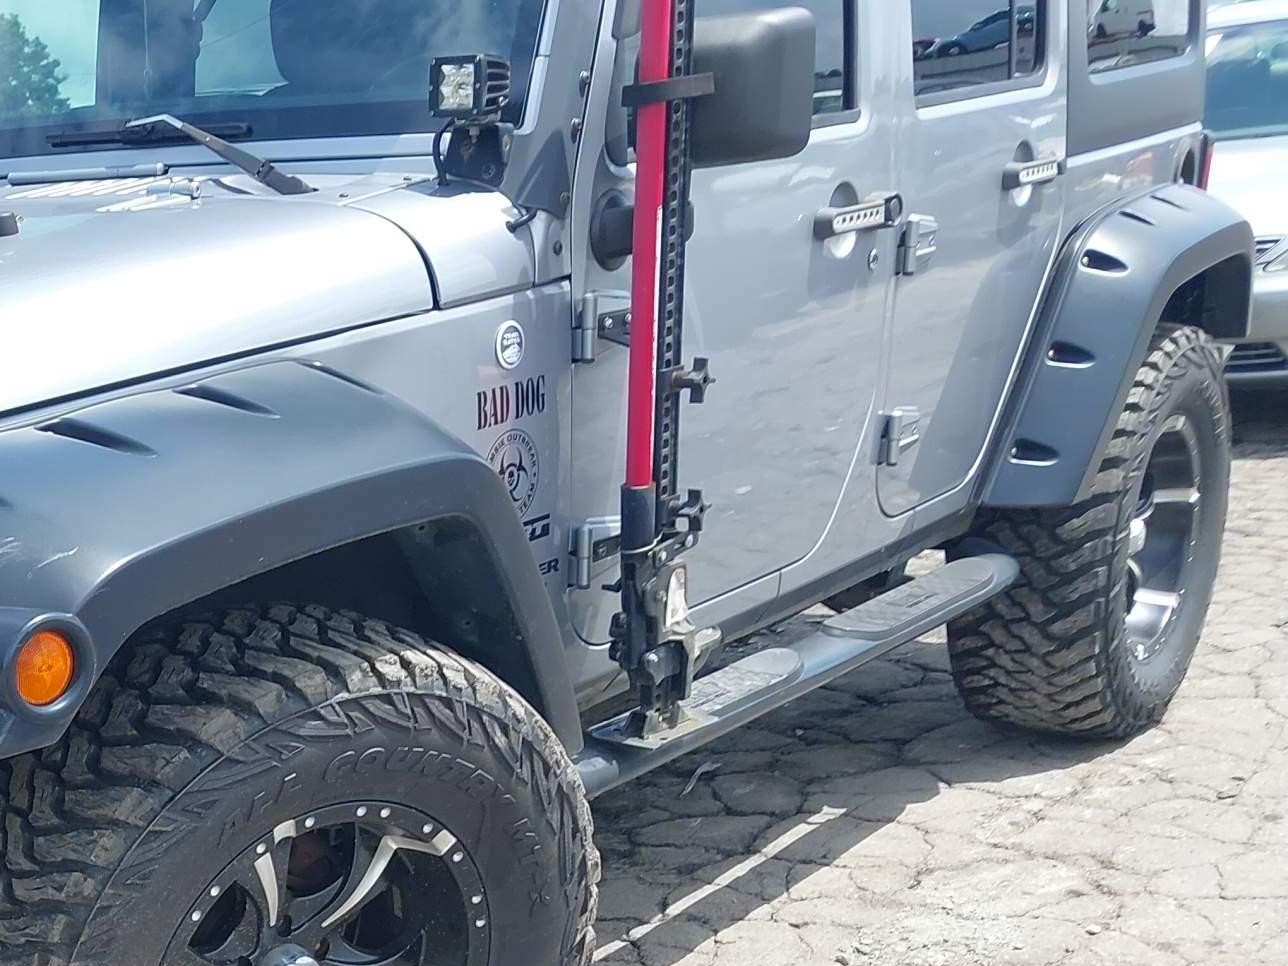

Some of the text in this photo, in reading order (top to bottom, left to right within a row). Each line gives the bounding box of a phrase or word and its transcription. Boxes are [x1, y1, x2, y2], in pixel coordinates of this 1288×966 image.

[476, 374, 546, 430] BAD DOG
[519, 482, 535, 514] TEAM
[322, 746, 516, 812] COUNTRY
